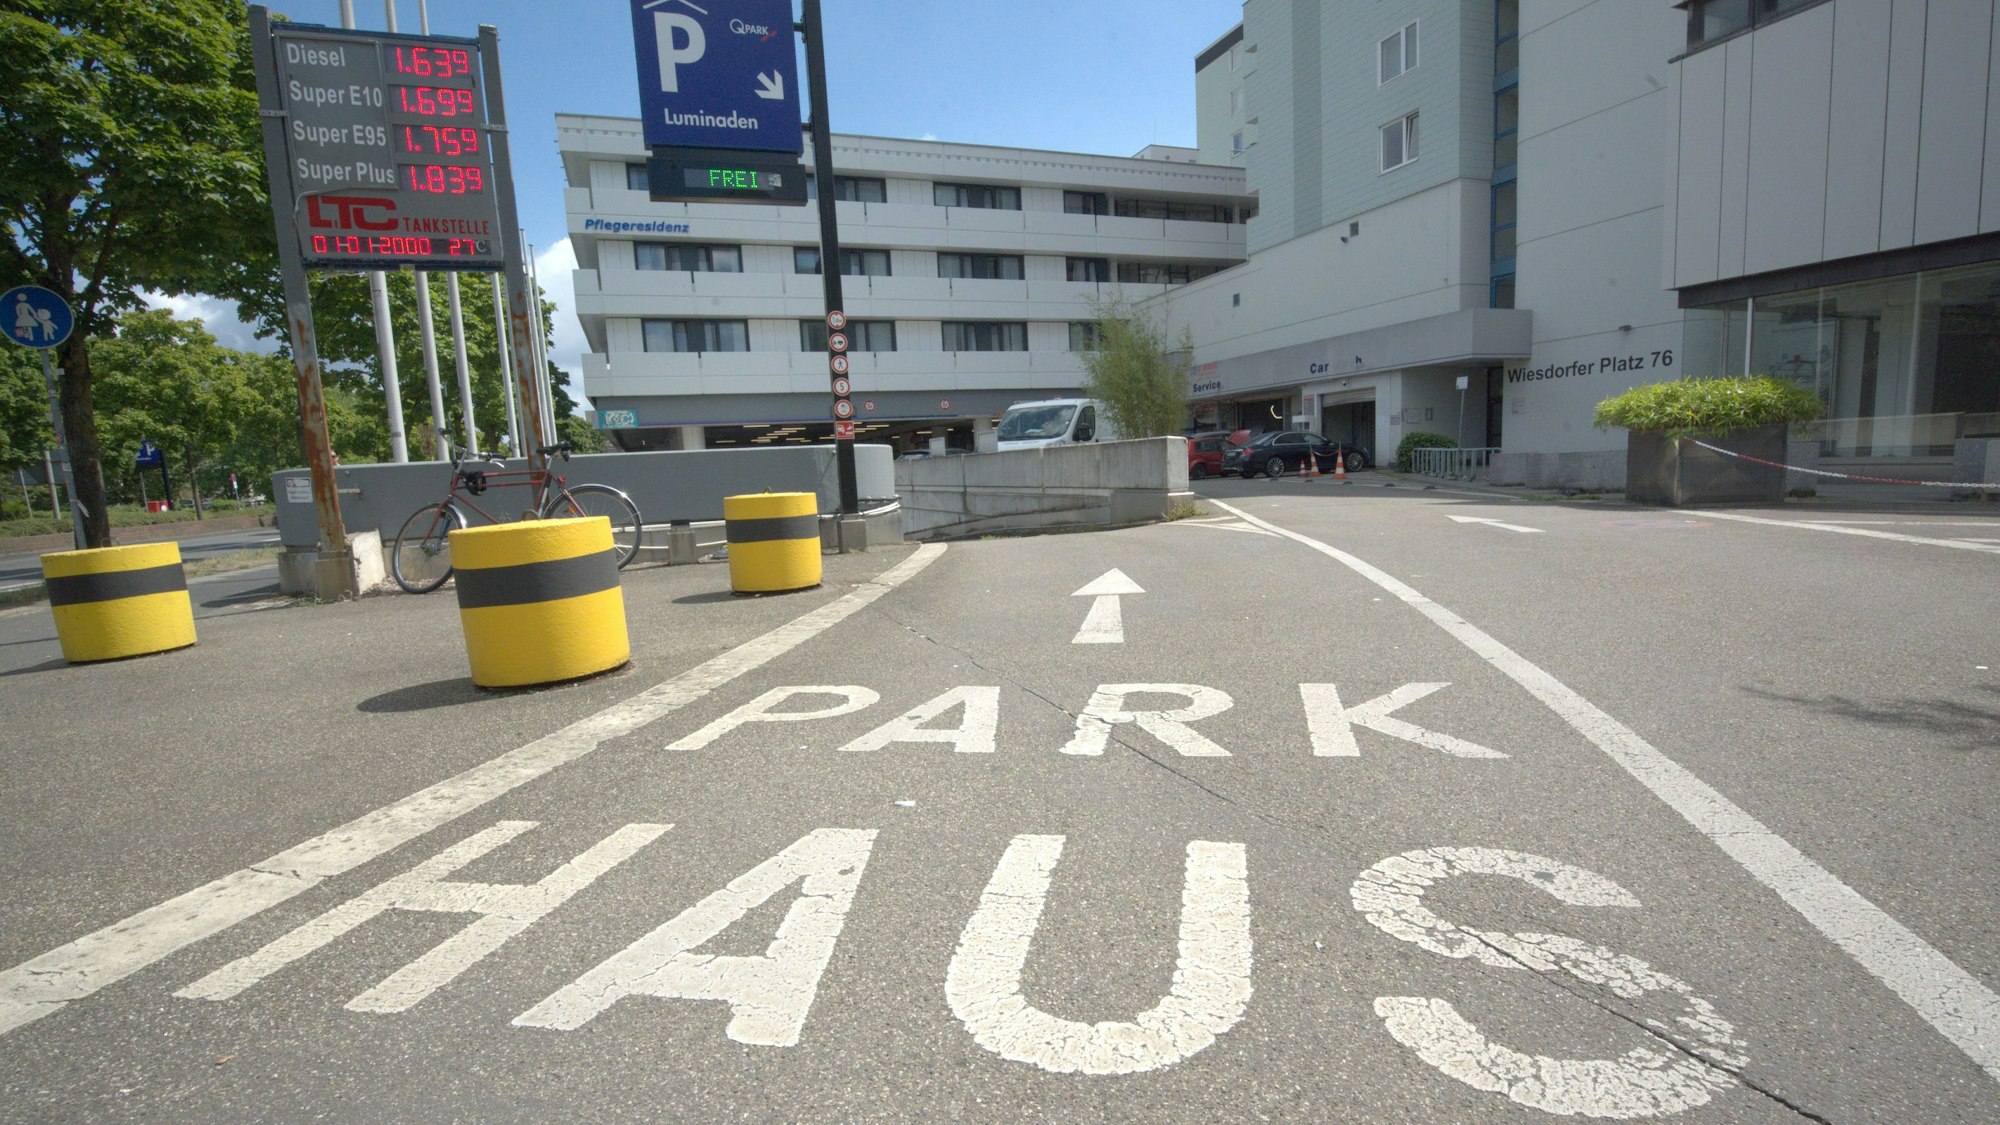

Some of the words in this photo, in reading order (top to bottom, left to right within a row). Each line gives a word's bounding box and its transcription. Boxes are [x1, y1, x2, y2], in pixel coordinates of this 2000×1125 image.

[286, 43, 346, 67] Diesel
[396, 47, 469, 77] 1.639
[654, 11, 706, 93] P
[290, 80, 344, 107] Super
[350, 86, 383, 108] E10
[401, 87, 473, 116] 1.699
[664, 108, 758, 130] Luminaden
[293, 120, 348, 147] Super
[353, 125, 386, 147] E95
[406, 126, 477, 156] 1.759
[297, 158, 351, 185] Super
[357, 162, 395, 184] Plus
[410, 165, 483, 194] 1.839
[709, 169, 758, 189] FREI
[306, 195, 399, 231] LTC
[403, 217, 490, 235] TANKSTELLE
[585, 219, 690, 233] Pflegeresidenz
[1310, 362, 1329, 374] Car
[1508, 361, 1595, 383] Wiesdorfer
[1600, 355, 1644, 373] Platz
[1651, 350, 1673, 368] 76
[1193, 380, 1221, 392] Service
[665, 682, 1512, 758] PARK
[172, 819, 1752, 1118] HAUS
